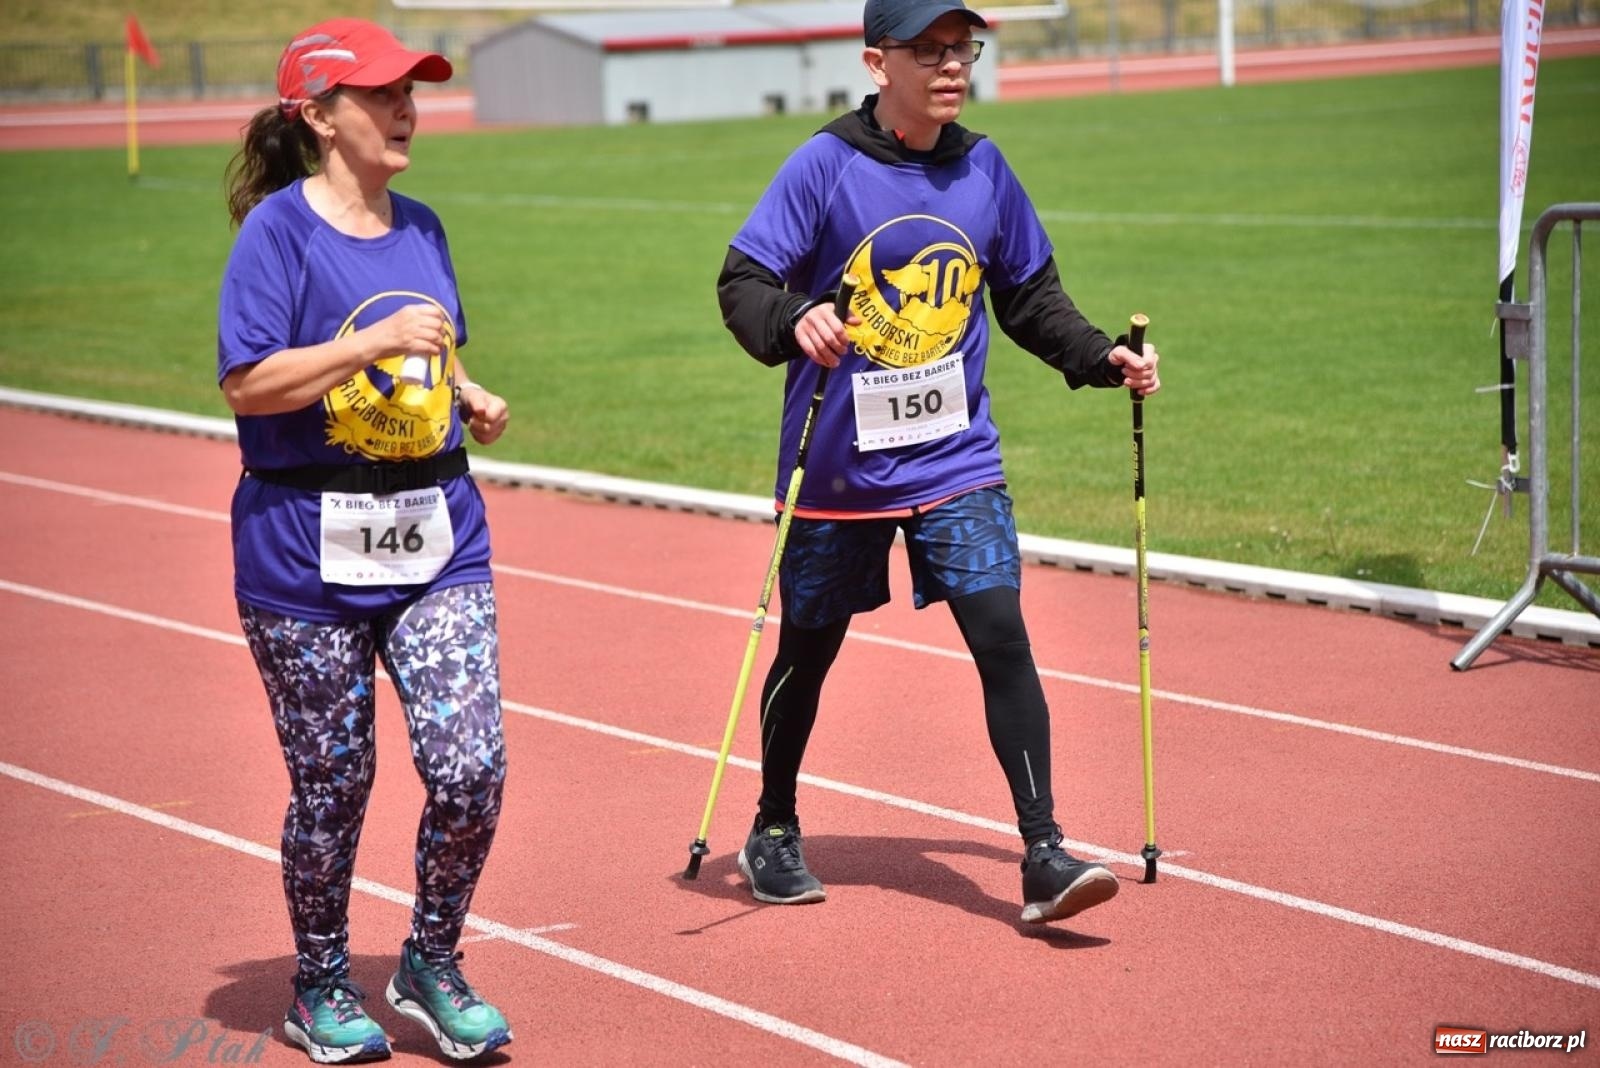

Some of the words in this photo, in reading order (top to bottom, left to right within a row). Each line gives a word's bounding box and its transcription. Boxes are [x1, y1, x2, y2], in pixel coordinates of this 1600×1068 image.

[921, 258, 967, 308] 10
[854, 289, 920, 350] RACIBORSKI
[881, 345, 901, 361] BIEG
[903, 353, 920, 363] BEZ
[921, 342, 945, 361] BARIER
[873, 375, 898, 385] BIEG
[902, 371, 921, 382] BEZ
[888, 389, 943, 421] 150
[373, 438, 397, 453] BIEG
[400, 441, 415, 454] BEZ
[346, 500, 374, 510] BIEG
[379, 499, 400, 509] BEZ
[360, 523, 424, 554] 146
